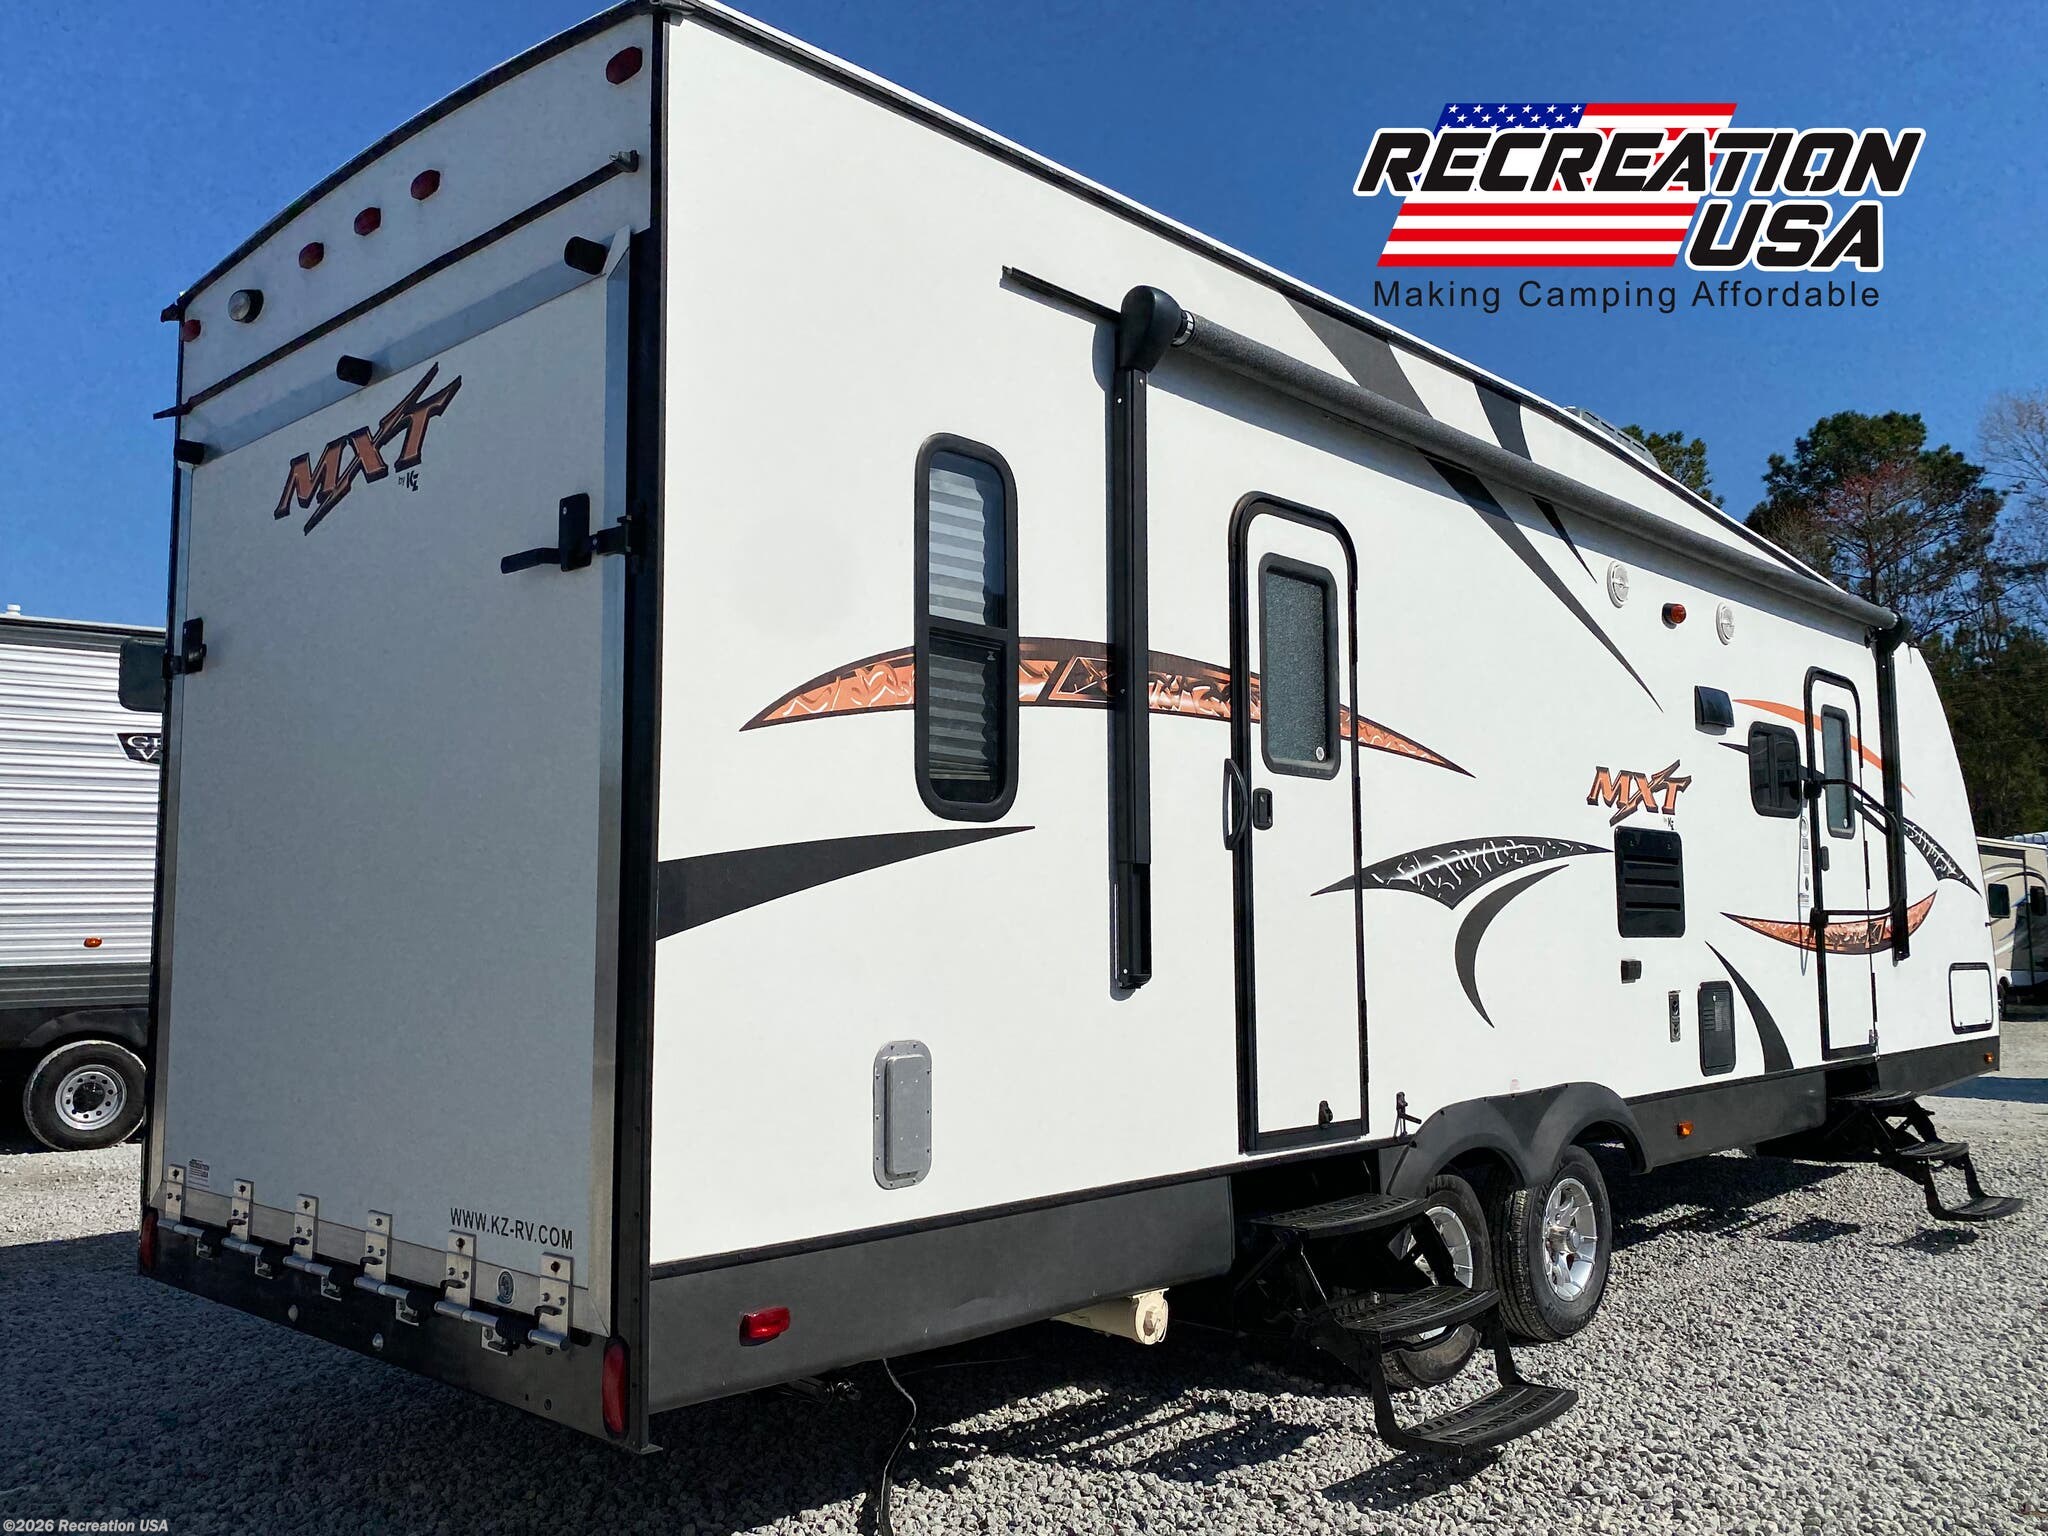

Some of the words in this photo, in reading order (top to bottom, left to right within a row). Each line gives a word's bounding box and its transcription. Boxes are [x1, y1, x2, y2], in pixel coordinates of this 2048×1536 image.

[273, 361, 463, 537] MXT
[1586, 759, 1693, 828] MXT
[450, 1207, 573, 1250] WWW.KZ-RV.COM
